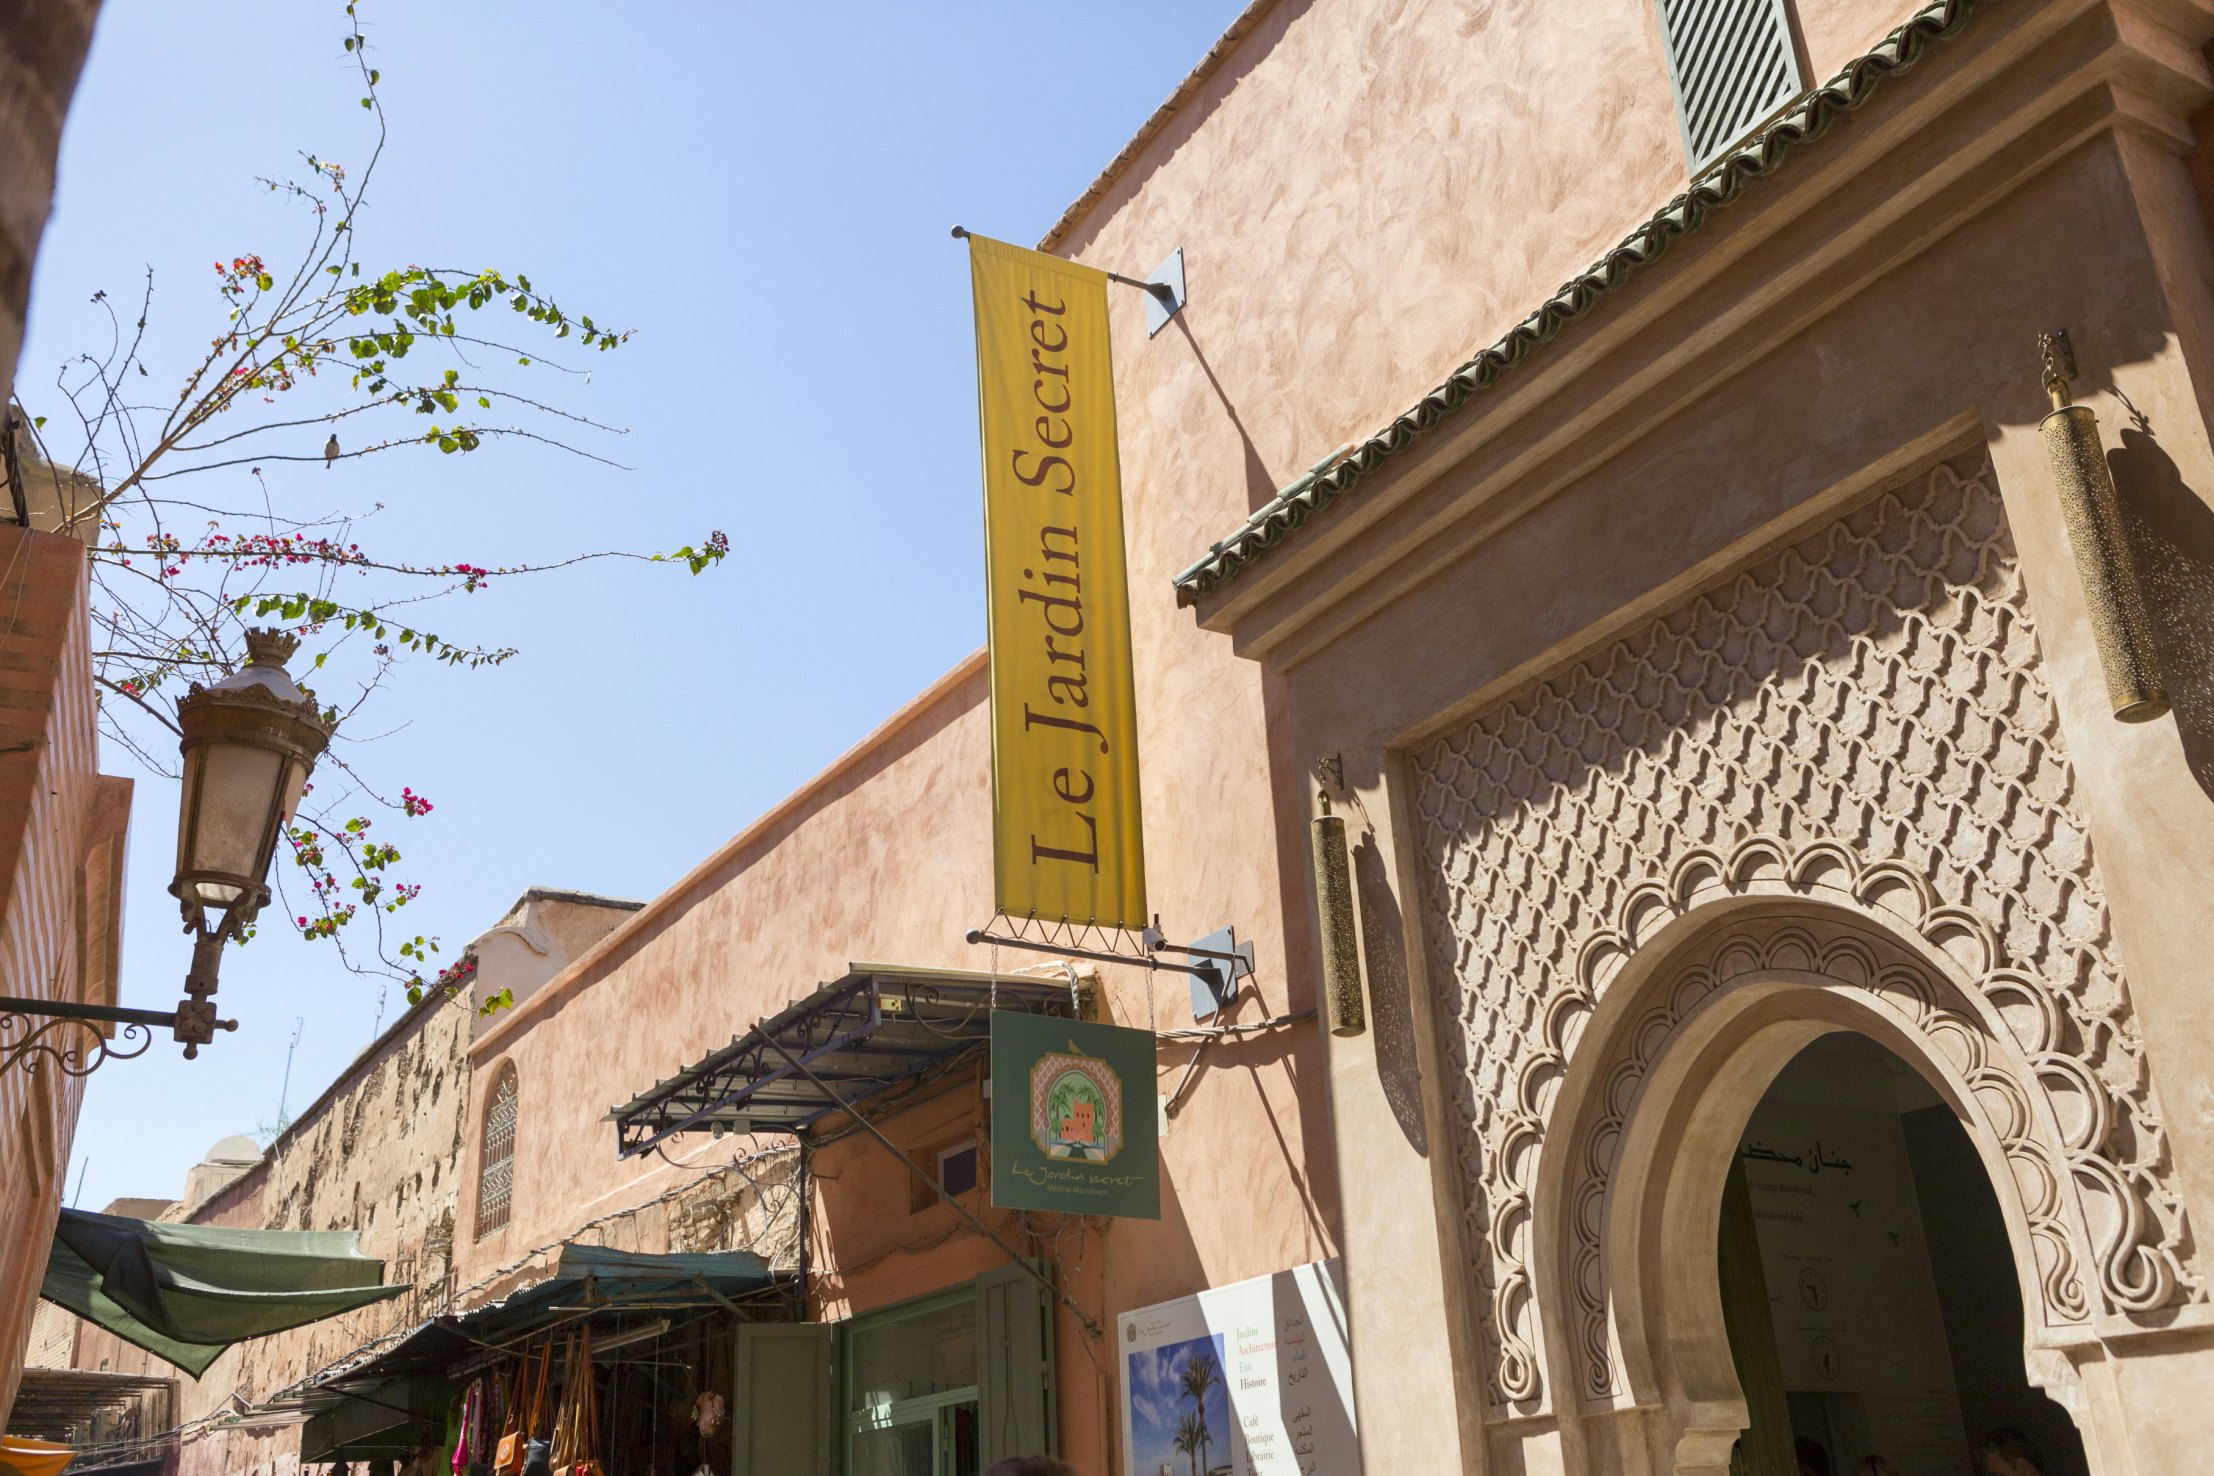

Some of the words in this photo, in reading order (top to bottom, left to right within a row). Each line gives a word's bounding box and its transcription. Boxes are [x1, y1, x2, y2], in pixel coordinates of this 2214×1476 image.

[1012, 289, 1076, 498] Secret
[1019, 525, 1110, 755] Jardin
[1032, 766, 1099, 874] Le
[1011, 1159, 1034, 1177] Le
[1029, 1165, 1084, 1186] Jardin
[1089, 1174, 1144, 1187] secret
[1236, 1326, 1259, 1343] Jardins
[1238, 1340, 1279, 1357] Architecture
[1239, 1361, 1253, 1373] Eau
[1240, 1376, 1267, 1390] Histoire
[1243, 1415, 1259, 1428] Café
[1245, 1432, 1275, 1446] Boutique
[1246, 1448, 1275, 1463] Librairie
